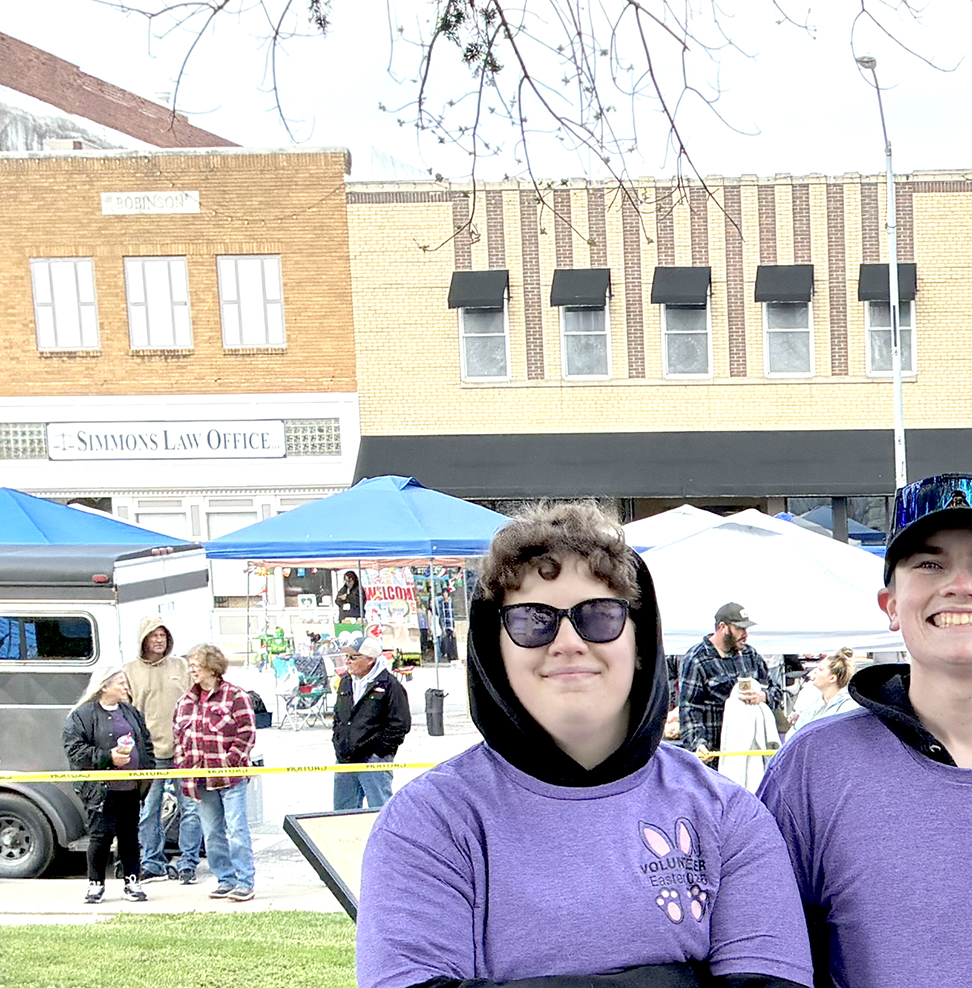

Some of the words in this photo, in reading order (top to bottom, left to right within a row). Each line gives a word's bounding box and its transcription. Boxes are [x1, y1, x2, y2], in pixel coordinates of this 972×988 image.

[116, 193, 184, 210] ROBINSON
[77, 431, 158, 451] SIMMONS
[163, 430, 201, 450] LAW
[206, 429, 271, 450] OFFICE
[640, 858, 706, 874] VOLUNEER
